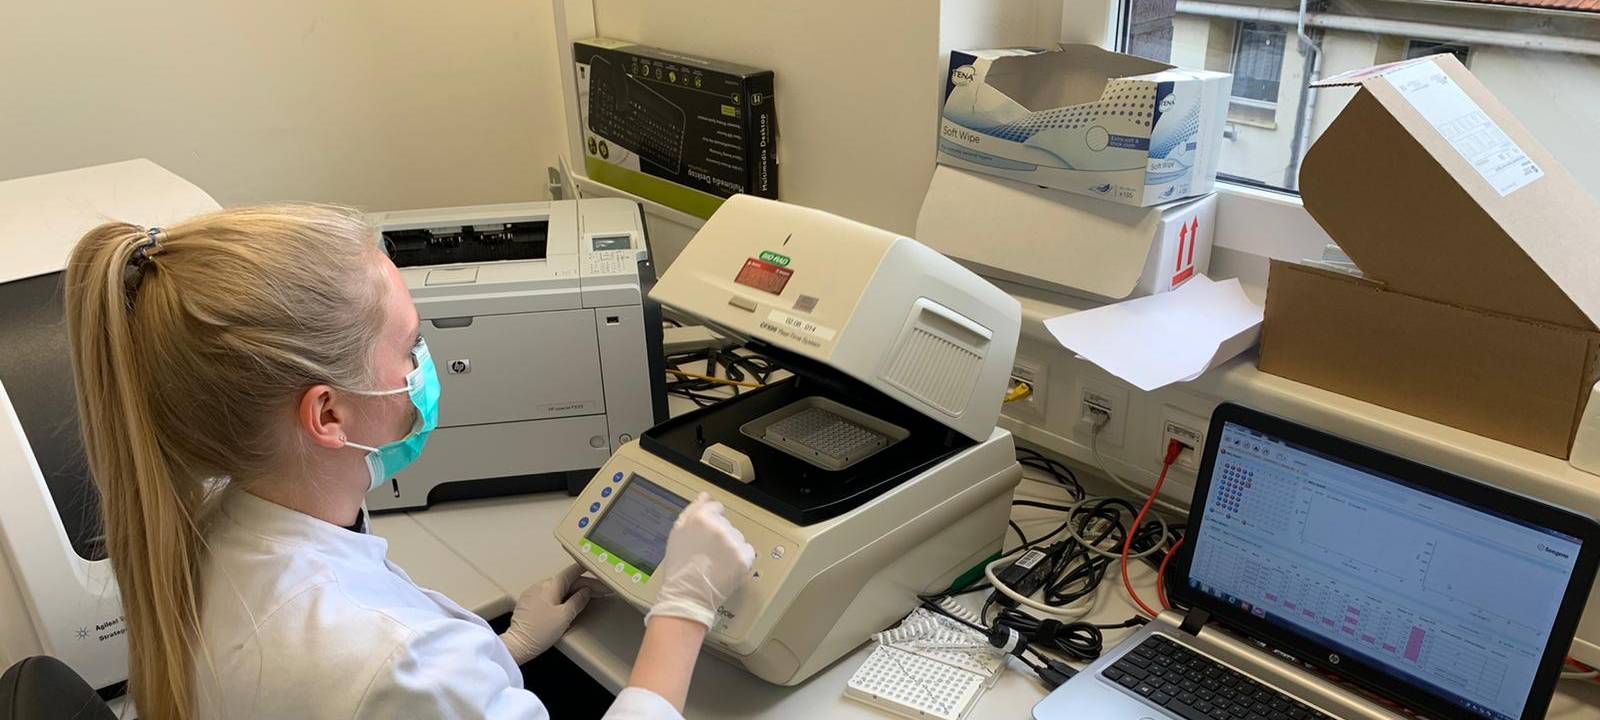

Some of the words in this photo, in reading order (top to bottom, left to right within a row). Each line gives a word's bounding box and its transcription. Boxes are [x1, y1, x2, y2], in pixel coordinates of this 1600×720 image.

[952, 70, 974, 81] TENA
[759, 114, 767, 148] Desktop
[943, 125, 958, 138] Soft
[959, 130, 981, 144] Wipe
[687, 169, 711, 184] Desktop
[759, 149, 767, 192] Multimedia
[712, 177, 745, 194] Multimedia
[96, 618, 119, 631] Agilent
